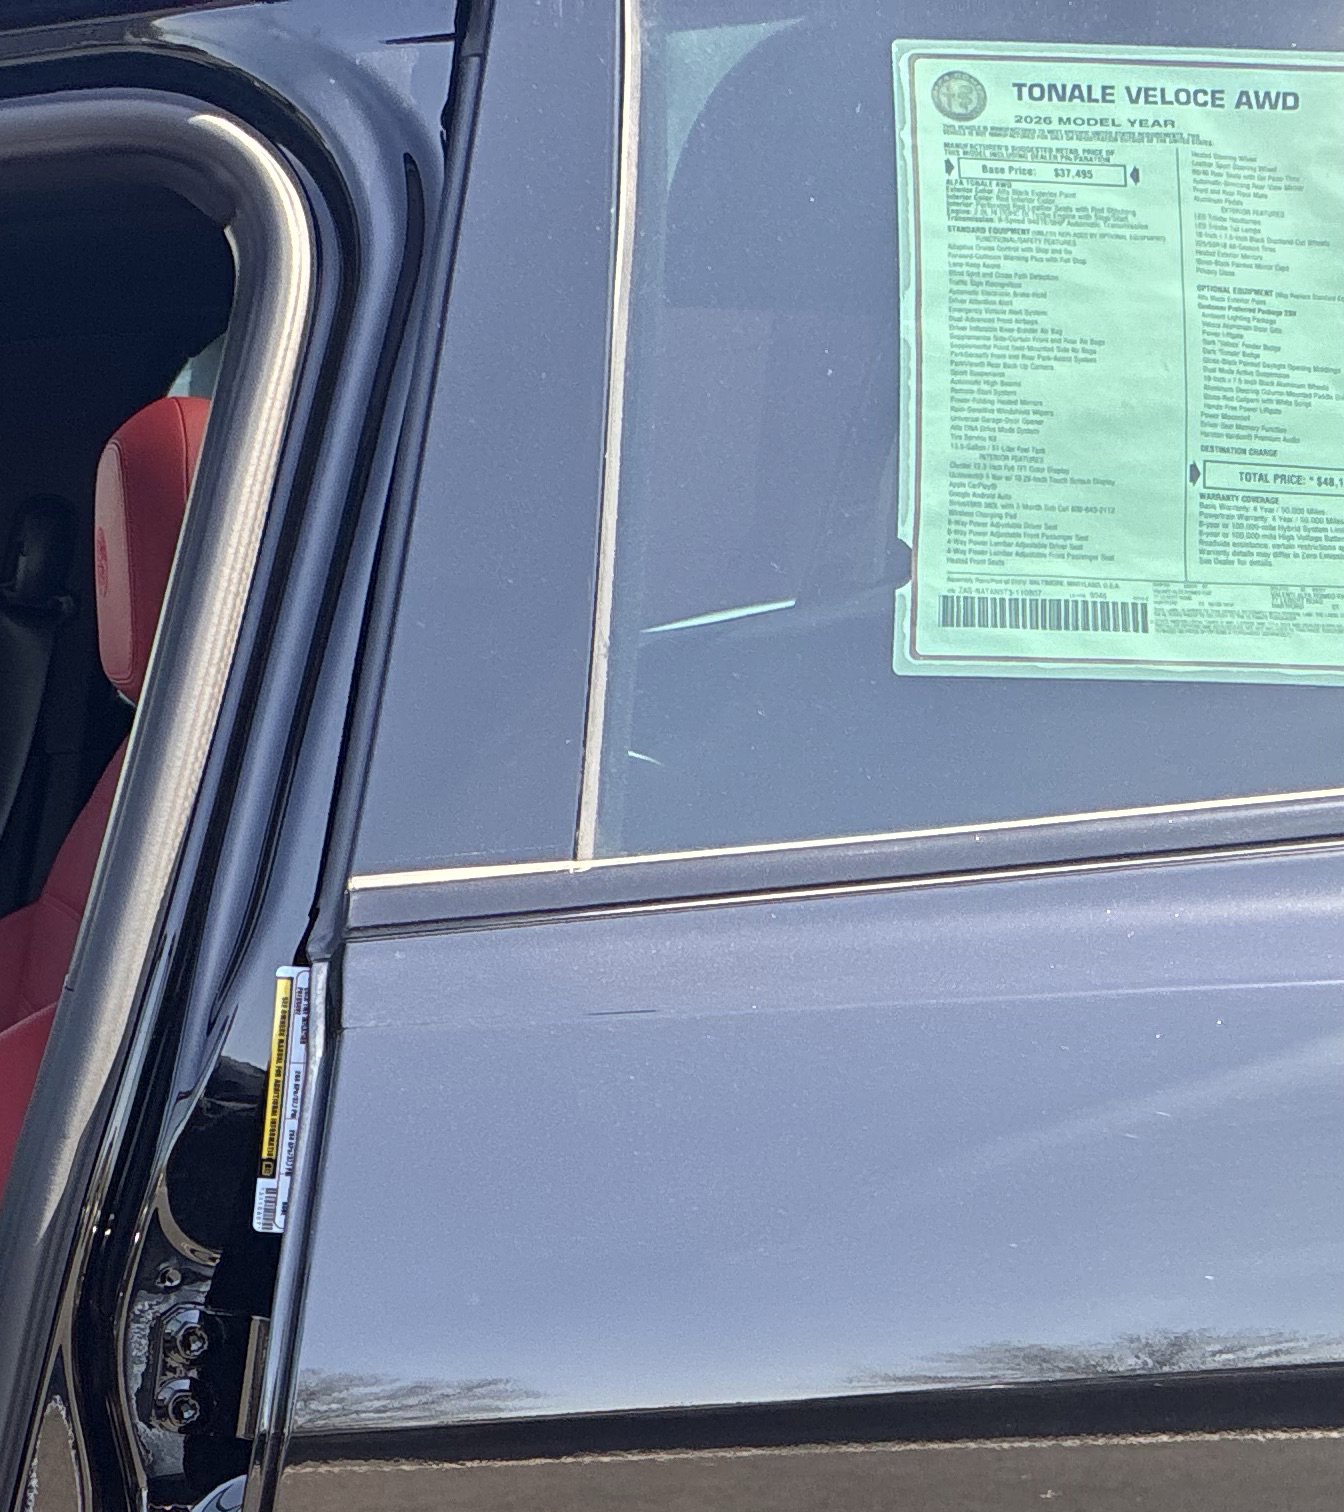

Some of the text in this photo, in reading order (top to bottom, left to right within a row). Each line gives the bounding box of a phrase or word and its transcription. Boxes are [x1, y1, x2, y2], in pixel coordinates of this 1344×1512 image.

[1012, 82, 1301, 112] TONALE VELOCE AWD
[1013, 114, 1177, 129] 2026 MODEL YEAR
[981, 164, 1093, 179] Base Price: $37,495
[1238, 471, 1270, 484] TOTAL
[1273, 474, 1306, 487] PRICE:
